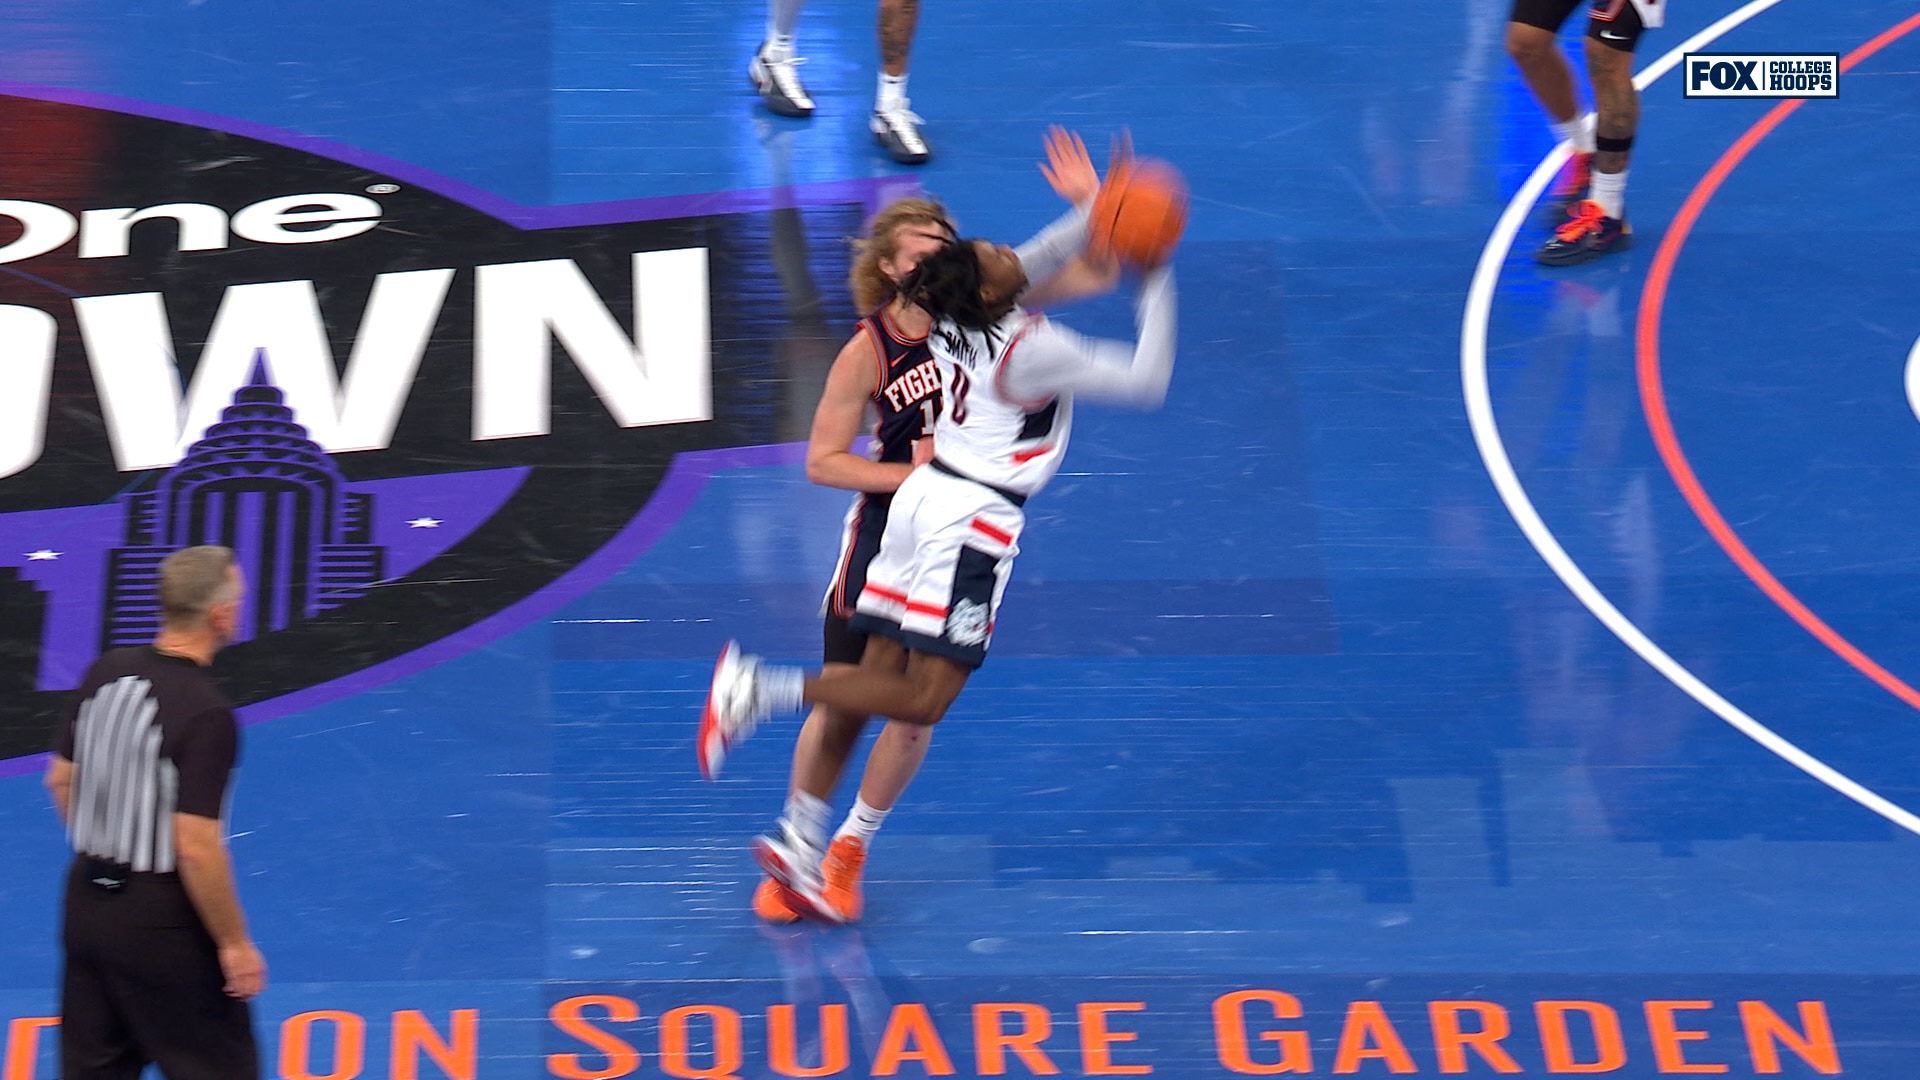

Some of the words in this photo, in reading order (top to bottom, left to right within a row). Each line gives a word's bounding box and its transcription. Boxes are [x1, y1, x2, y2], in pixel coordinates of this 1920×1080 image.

[944, 330, 978, 372] SMITH
[883, 357, 943, 414] FIGH
[950, 362, 971, 426] 0
[547, 994, 1153, 1080] SQUARE
[1211, 988, 1843, 1076] GARDEN
